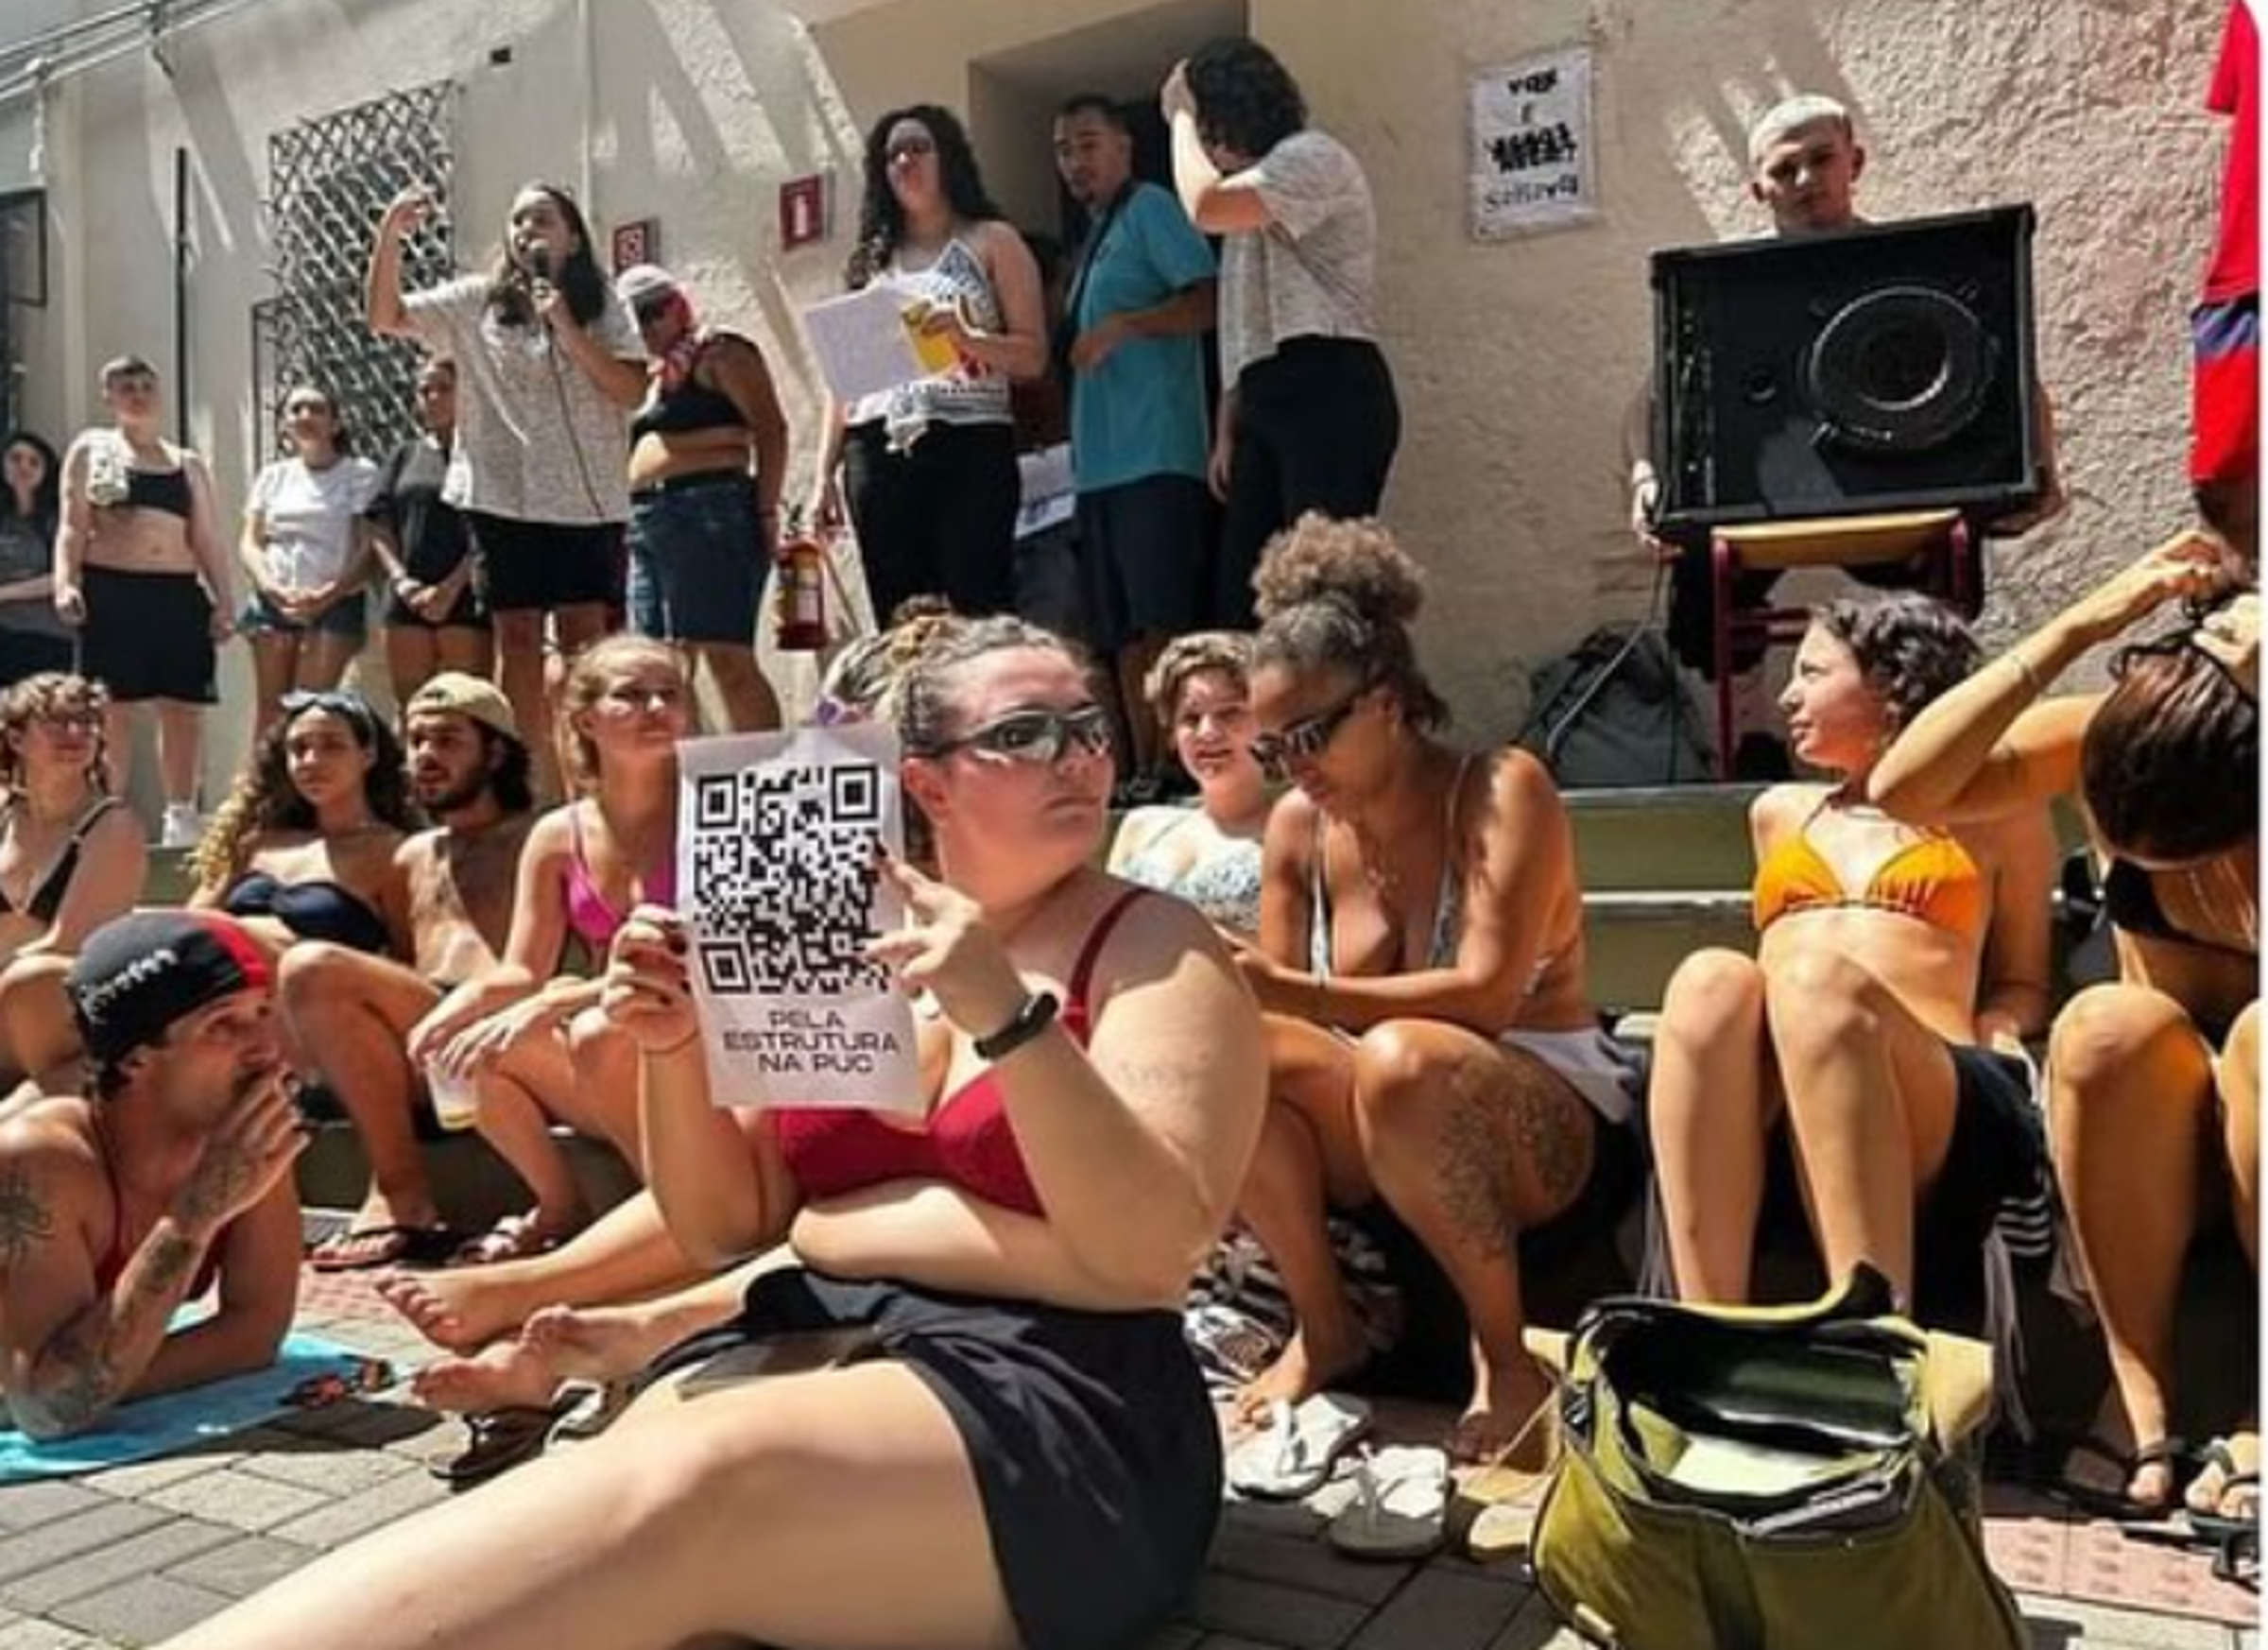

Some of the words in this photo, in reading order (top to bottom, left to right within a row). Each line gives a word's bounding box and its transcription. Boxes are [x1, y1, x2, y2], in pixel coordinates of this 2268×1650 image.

[768, 1010, 845, 1028] PELA
[723, 1032, 900, 1053] ESTRUTURA
[759, 1054, 802, 1073] NA
[814, 1054, 872, 1073] PUC
